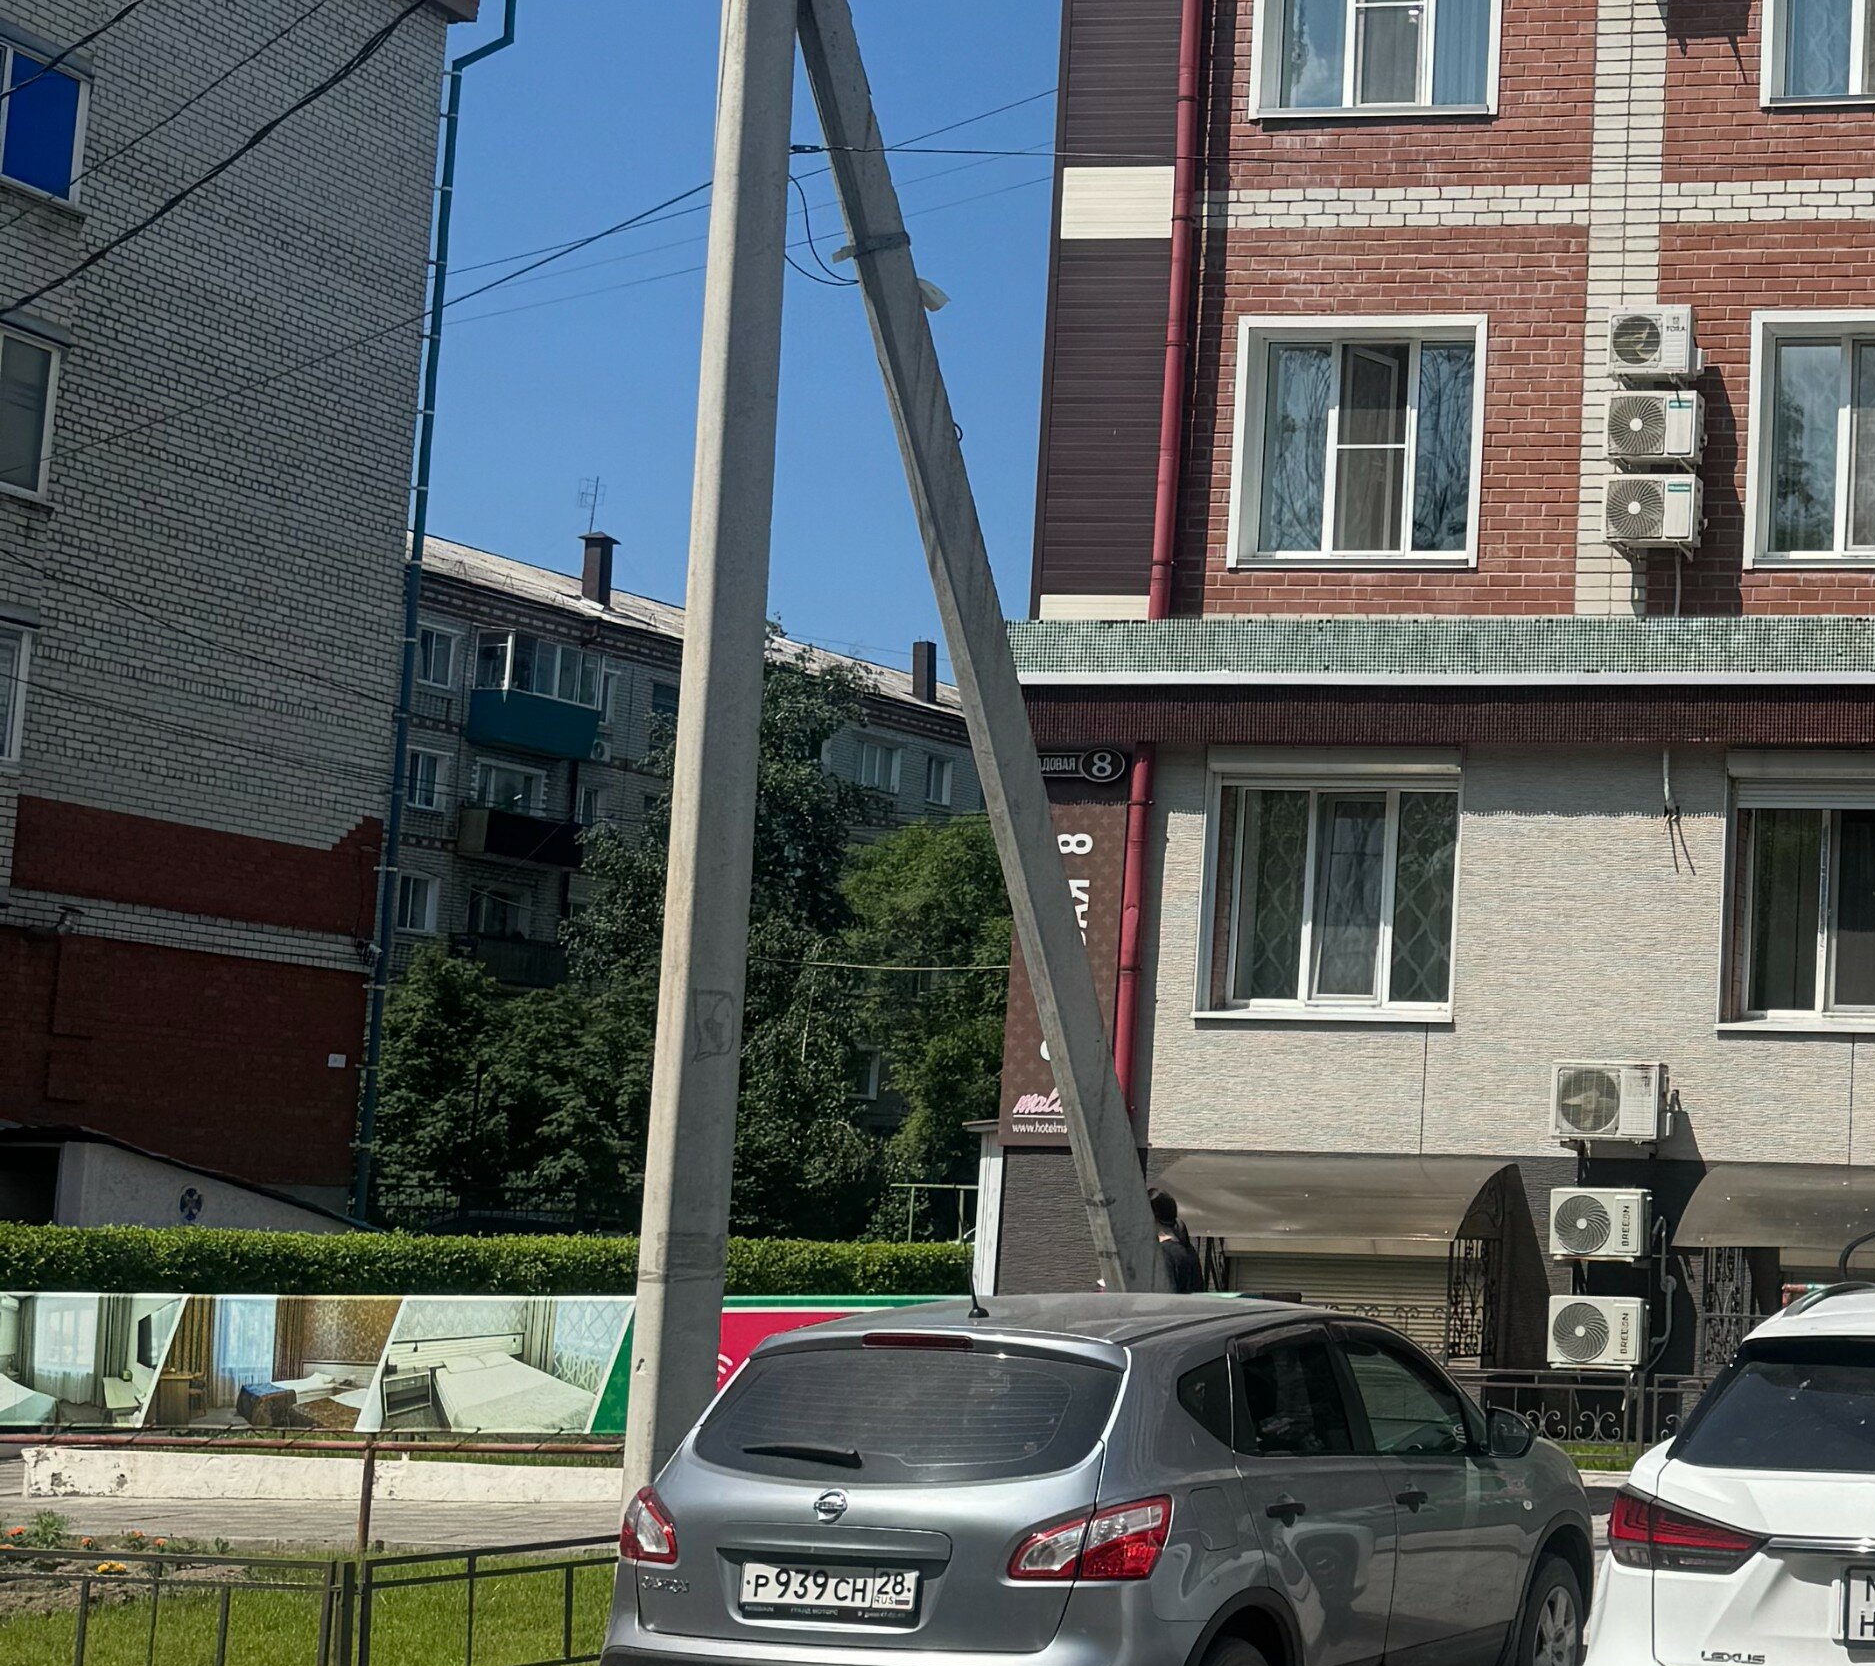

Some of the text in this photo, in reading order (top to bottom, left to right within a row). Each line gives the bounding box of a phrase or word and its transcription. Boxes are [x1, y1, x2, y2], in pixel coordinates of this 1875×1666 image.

[1039, 753, 1112, 777] ДОВАЯ 8
[1057, 833, 1094, 855] 8
[876, 1571, 905, 1596] 28
[873, 1596, 894, 1606] RUS
[1701, 1650, 1766, 1666] LEXUS
